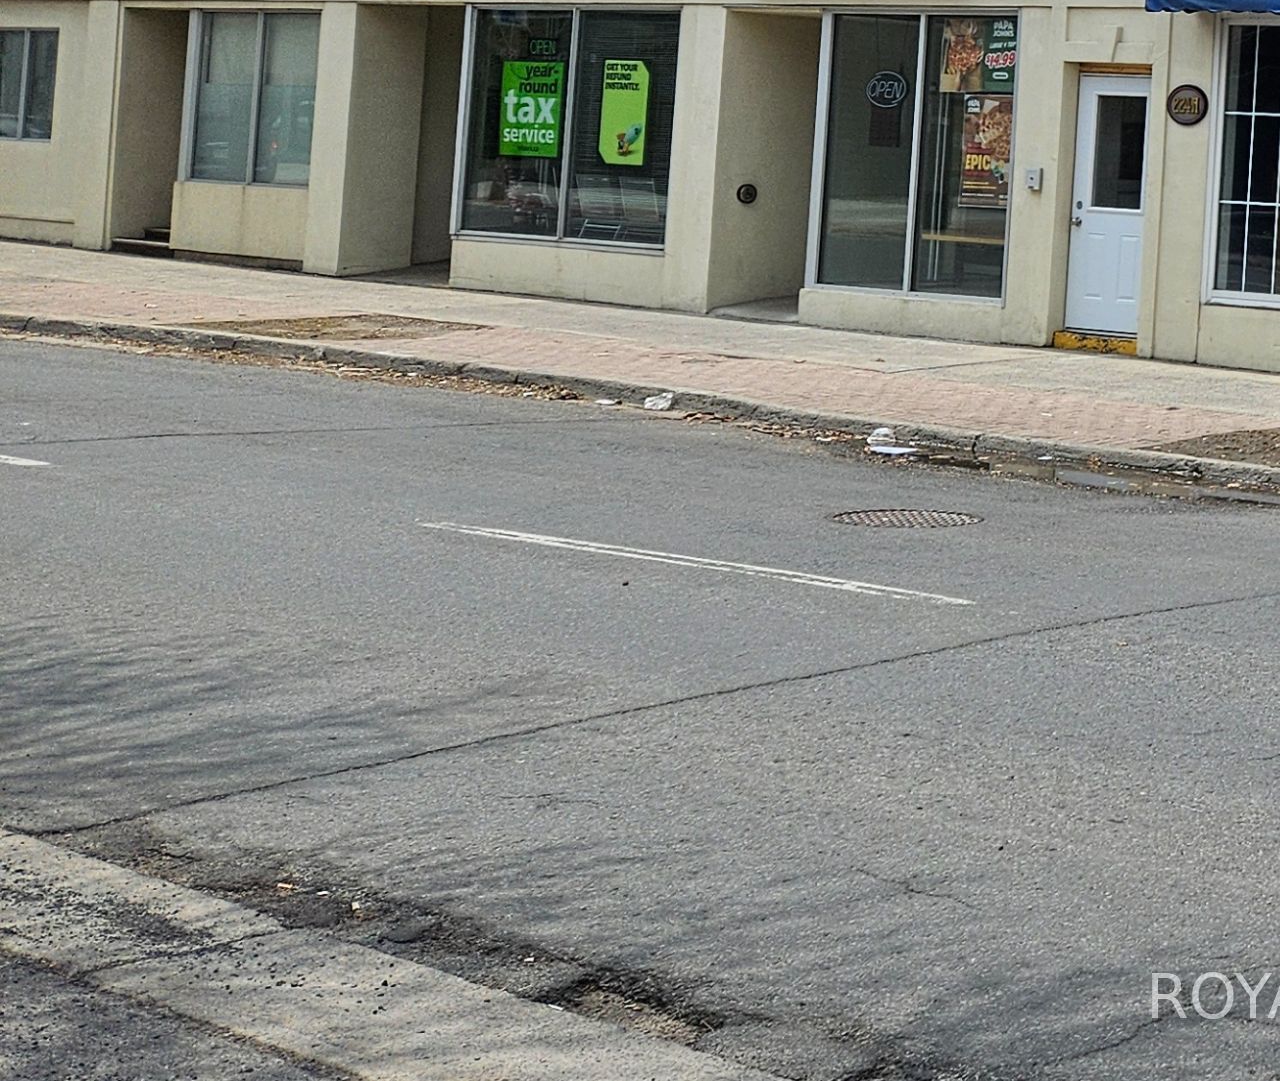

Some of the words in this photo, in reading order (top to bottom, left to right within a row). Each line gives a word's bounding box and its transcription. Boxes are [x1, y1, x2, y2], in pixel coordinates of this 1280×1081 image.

[529, 39, 557, 56] OPEN
[525, 63, 559, 81] year-
[518, 80, 558, 94] round
[868, 79, 904, 100] OPEN
[504, 88, 557, 124] tax
[503, 124, 555, 144] service
[965, 154, 992, 170] EPIC
